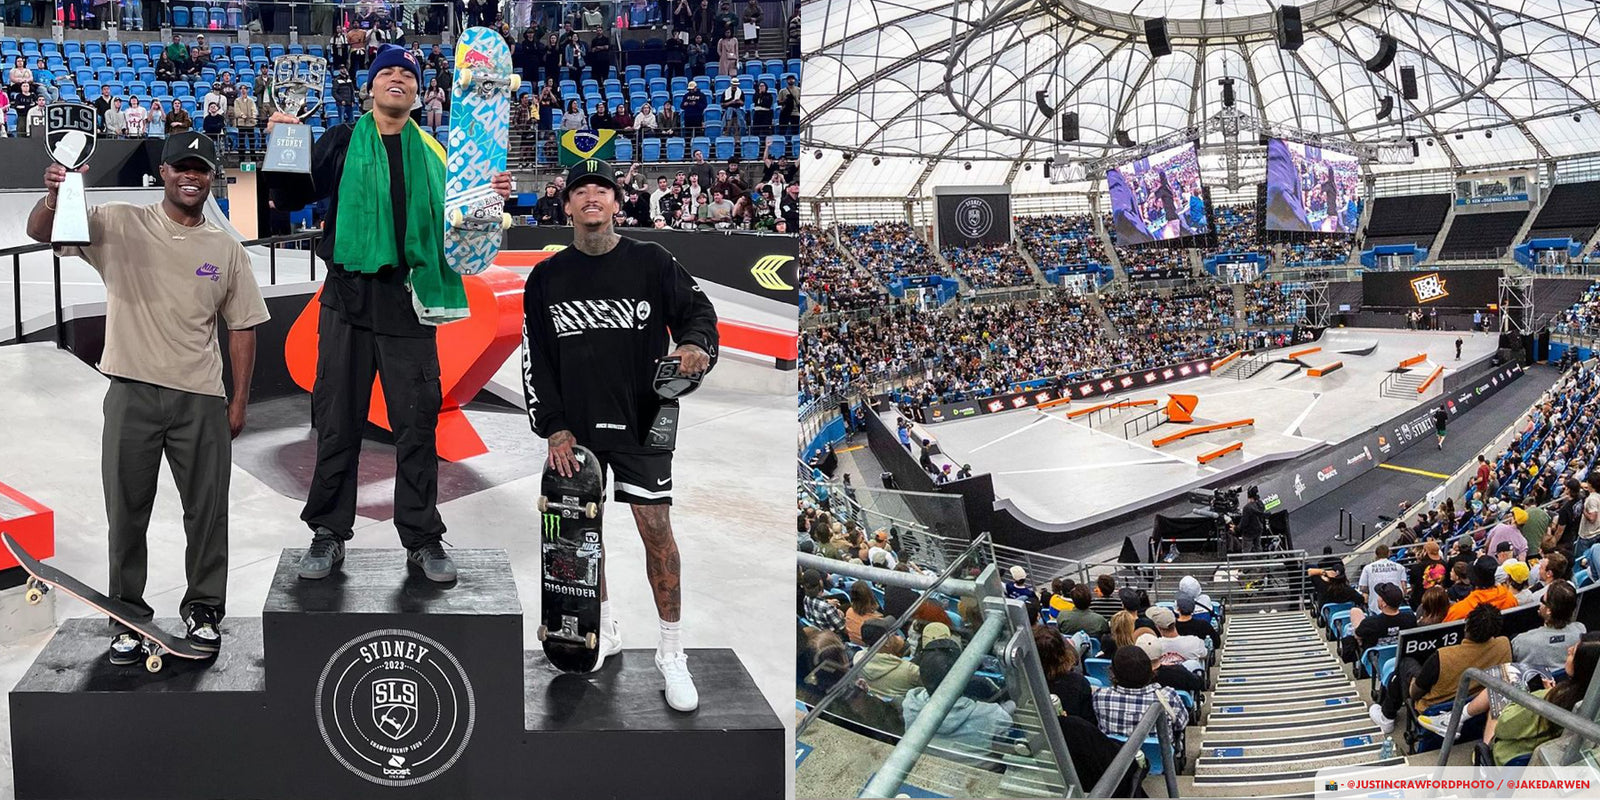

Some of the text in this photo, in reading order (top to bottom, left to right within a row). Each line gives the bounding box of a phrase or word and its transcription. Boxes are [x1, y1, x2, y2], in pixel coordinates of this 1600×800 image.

[278, 60, 322, 83] SLS
[49, 106, 93, 129] SLS
[276, 139, 303, 147] SYDNEY
[201, 262, 220, 273] NIKE
[1413, 275, 1438, 292] TECH
[1418, 284, 1445, 300] DECK
[581, 542, 601, 552] NIKE
[544, 582, 596, 598] DISORDER
[1405, 640, 1437, 654] Box
[1442, 632, 1458, 646] 13
[360, 641, 428, 663] SYDNEY
[384, 661, 405, 670] 2023
[375, 682, 415, 704] SLS
[370, 740, 423, 753] CHAMPIONSHIP TOUR
[383, 767, 411, 776] boost
